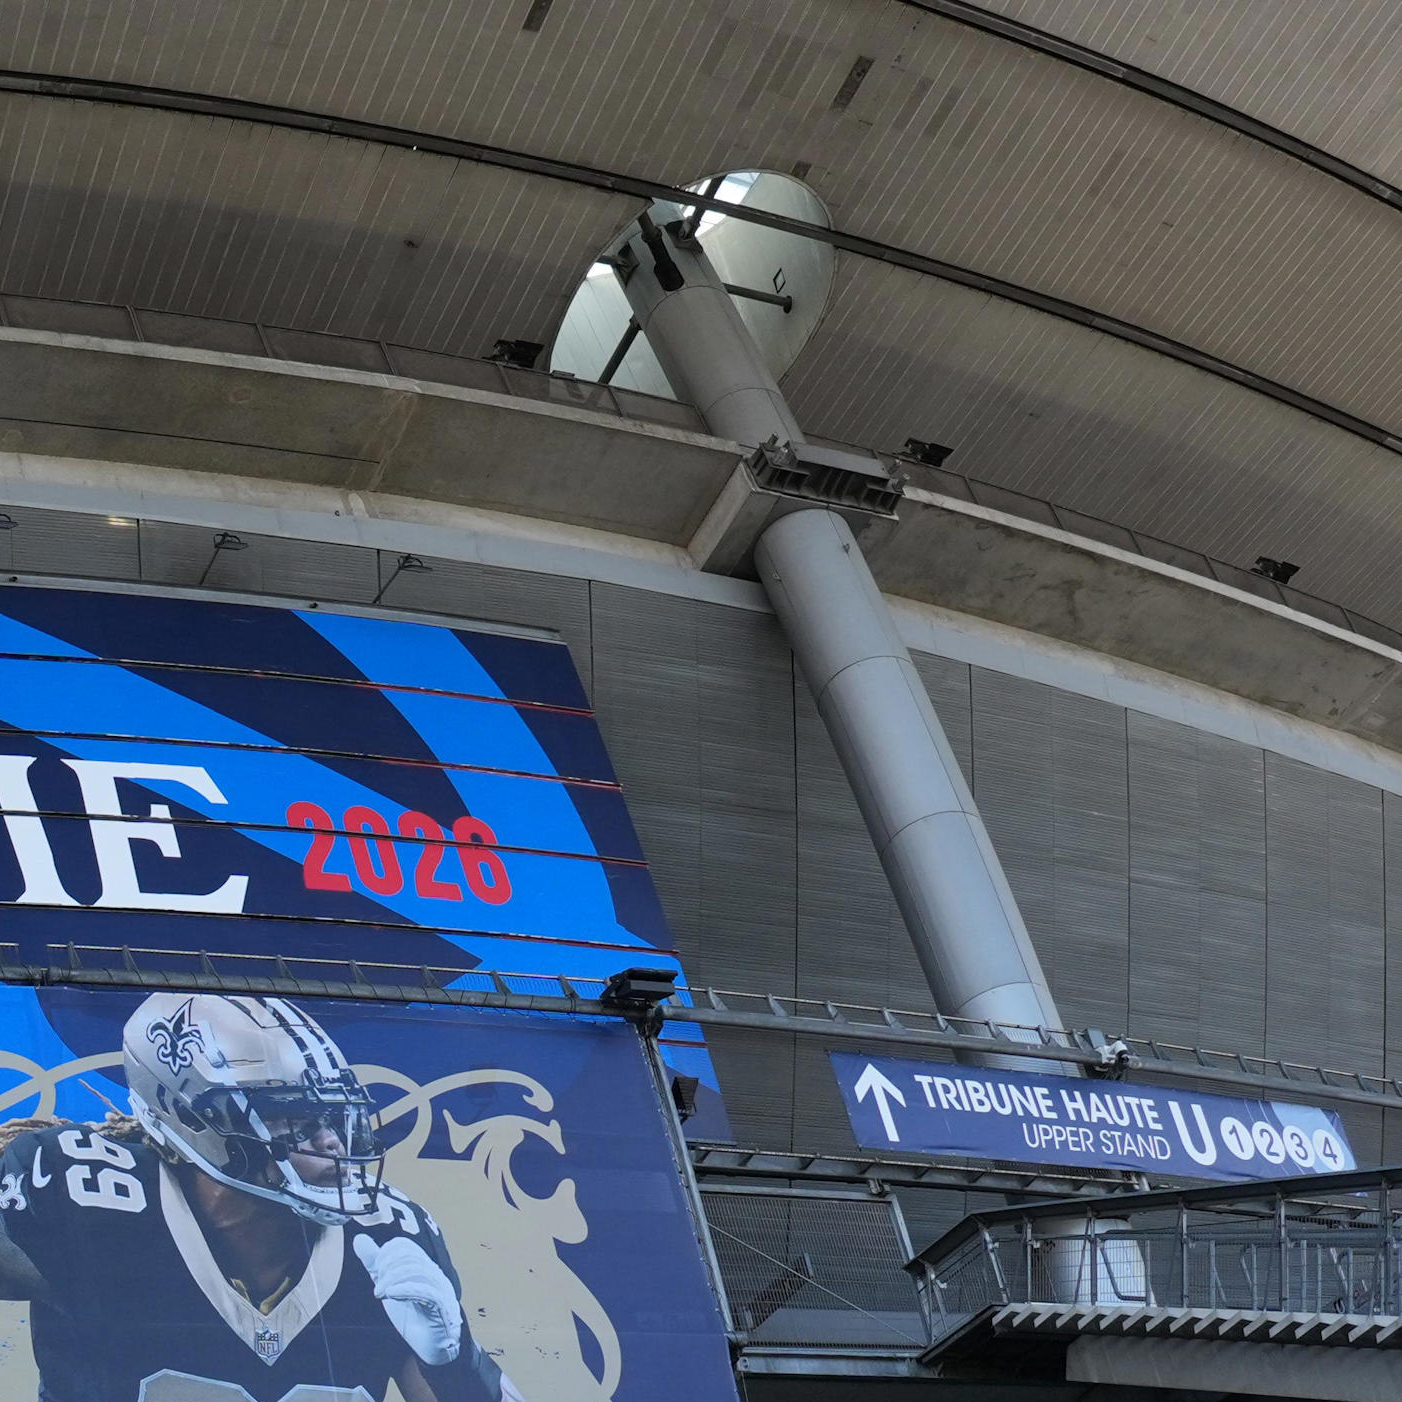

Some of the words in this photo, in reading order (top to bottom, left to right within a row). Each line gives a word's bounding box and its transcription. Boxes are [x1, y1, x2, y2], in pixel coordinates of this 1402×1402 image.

[285, 800, 513, 904] 2026
[913, 1074, 1059, 1120] TRIBUNE
[1059, 1089, 1164, 1131] HAUTE
[1022, 1123, 1095, 1153] UPPER
[1101, 1129, 1171, 1160] STAND
[1167, 1100, 1217, 1166] U
[1259, 1128, 1280, 1157] 2
[1290, 1132, 1309, 1161] 3
[259, 1342, 279, 1355] NFL
